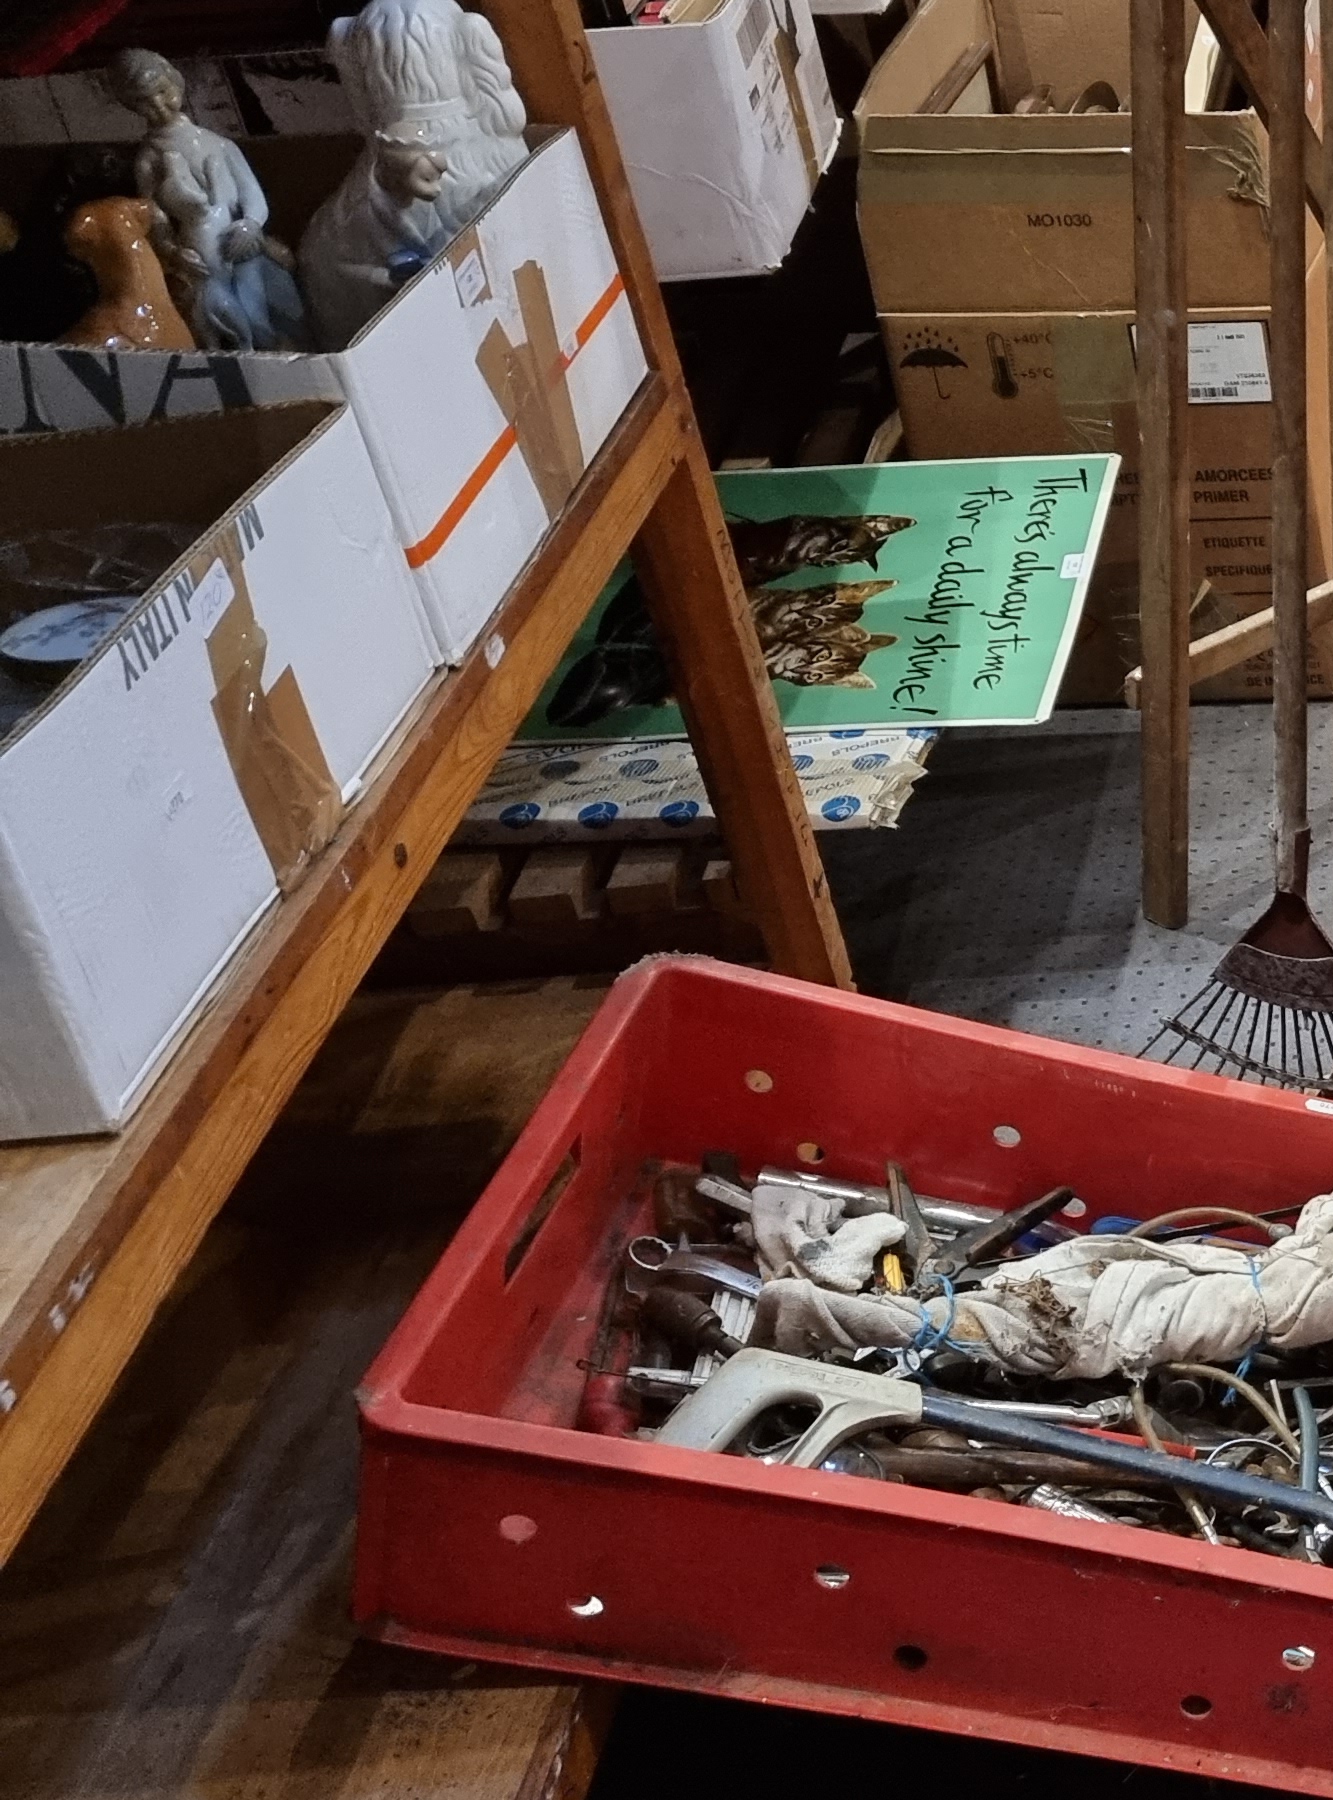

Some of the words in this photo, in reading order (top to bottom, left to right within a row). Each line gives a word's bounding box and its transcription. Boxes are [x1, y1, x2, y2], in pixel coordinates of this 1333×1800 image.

[1027, 214, 1092, 227] MO1030
[957, 485, 1014, 535] for
[1013, 467, 1088, 543] There's
[1193, 489, 1250, 503] PRIMER
[945, 535, 975, 558] a
[1203, 536, 1266, 549] ETIQUETTE
[903, 561, 985, 626] daily
[980, 551, 1056, 632] always
[889, 633, 961, 716] shine!
[973, 633, 1031, 691] time
